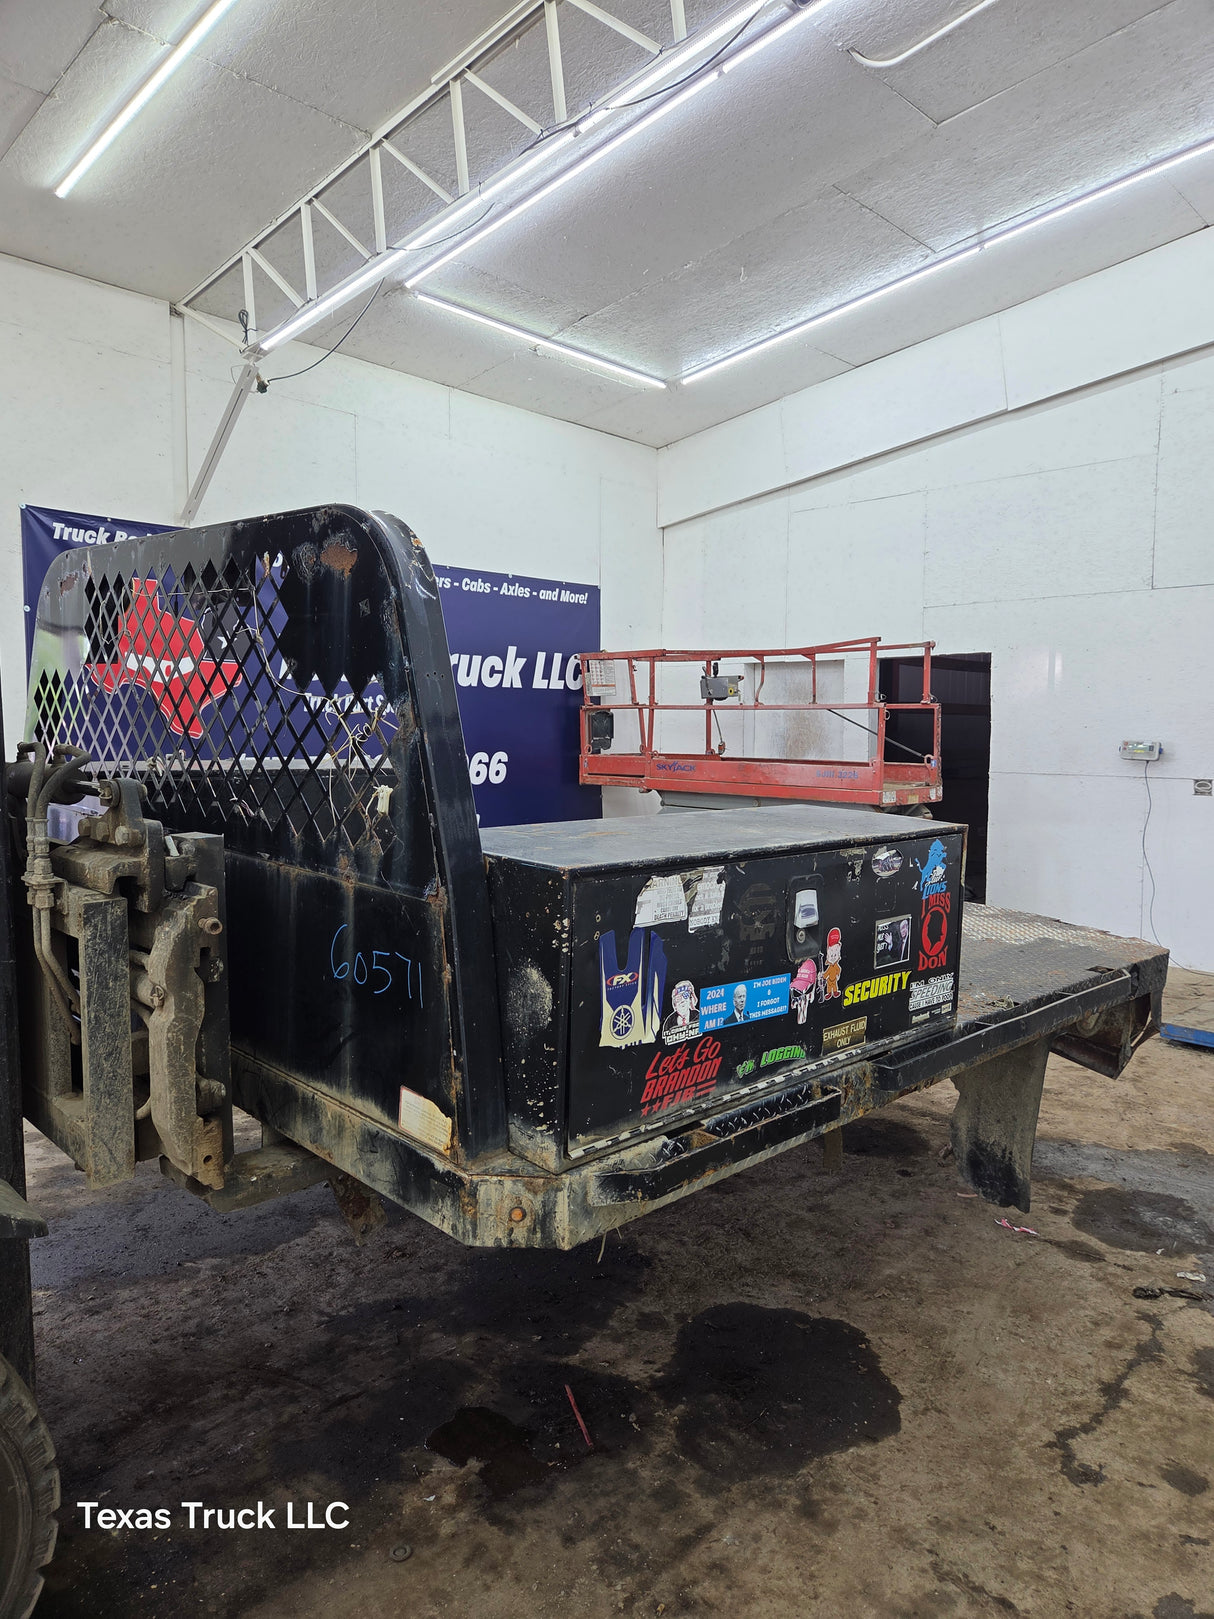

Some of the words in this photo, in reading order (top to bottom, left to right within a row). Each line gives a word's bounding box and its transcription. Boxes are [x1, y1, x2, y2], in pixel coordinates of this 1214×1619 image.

[52, 522, 110, 544] Truck
[462, 578, 491, 593] Cabs
[500, 582, 530, 598] Axles
[539, 589, 559, 601] and
[560, 590, 588, 604] More!
[450, 646, 527, 688] ruck
[532, 651, 583, 690] LLC
[467, 751, 508, 785] 66
[656, 761, 696, 772] SKYJACK
[928, 892, 951, 914] MISS
[331, 924, 424, 1009] 60571
[917, 945, 948, 971] DON
[612, 972, 634, 986] FX
[762, 979, 772, 987] JOE
[772, 976, 787, 985] BIDEN
[843, 970, 912, 1007] SECURITY
[706, 988, 725, 1000] 2024
[911, 981, 954, 1000] SPEEDING
[701, 1002, 727, 1016] WHERE
[704, 1019, 716, 1030] AM
[823, 1026, 849, 1042] EXHAUST
[850, 1020, 867, 1033] FLUID
[836, 1036, 851, 1048] ONLY
[646, 1042, 690, 1080] Let's
[693, 1036, 721, 1063] Go
[640, 1057, 723, 1104] BRANDON
[661, 1086, 696, 1110] FJB
